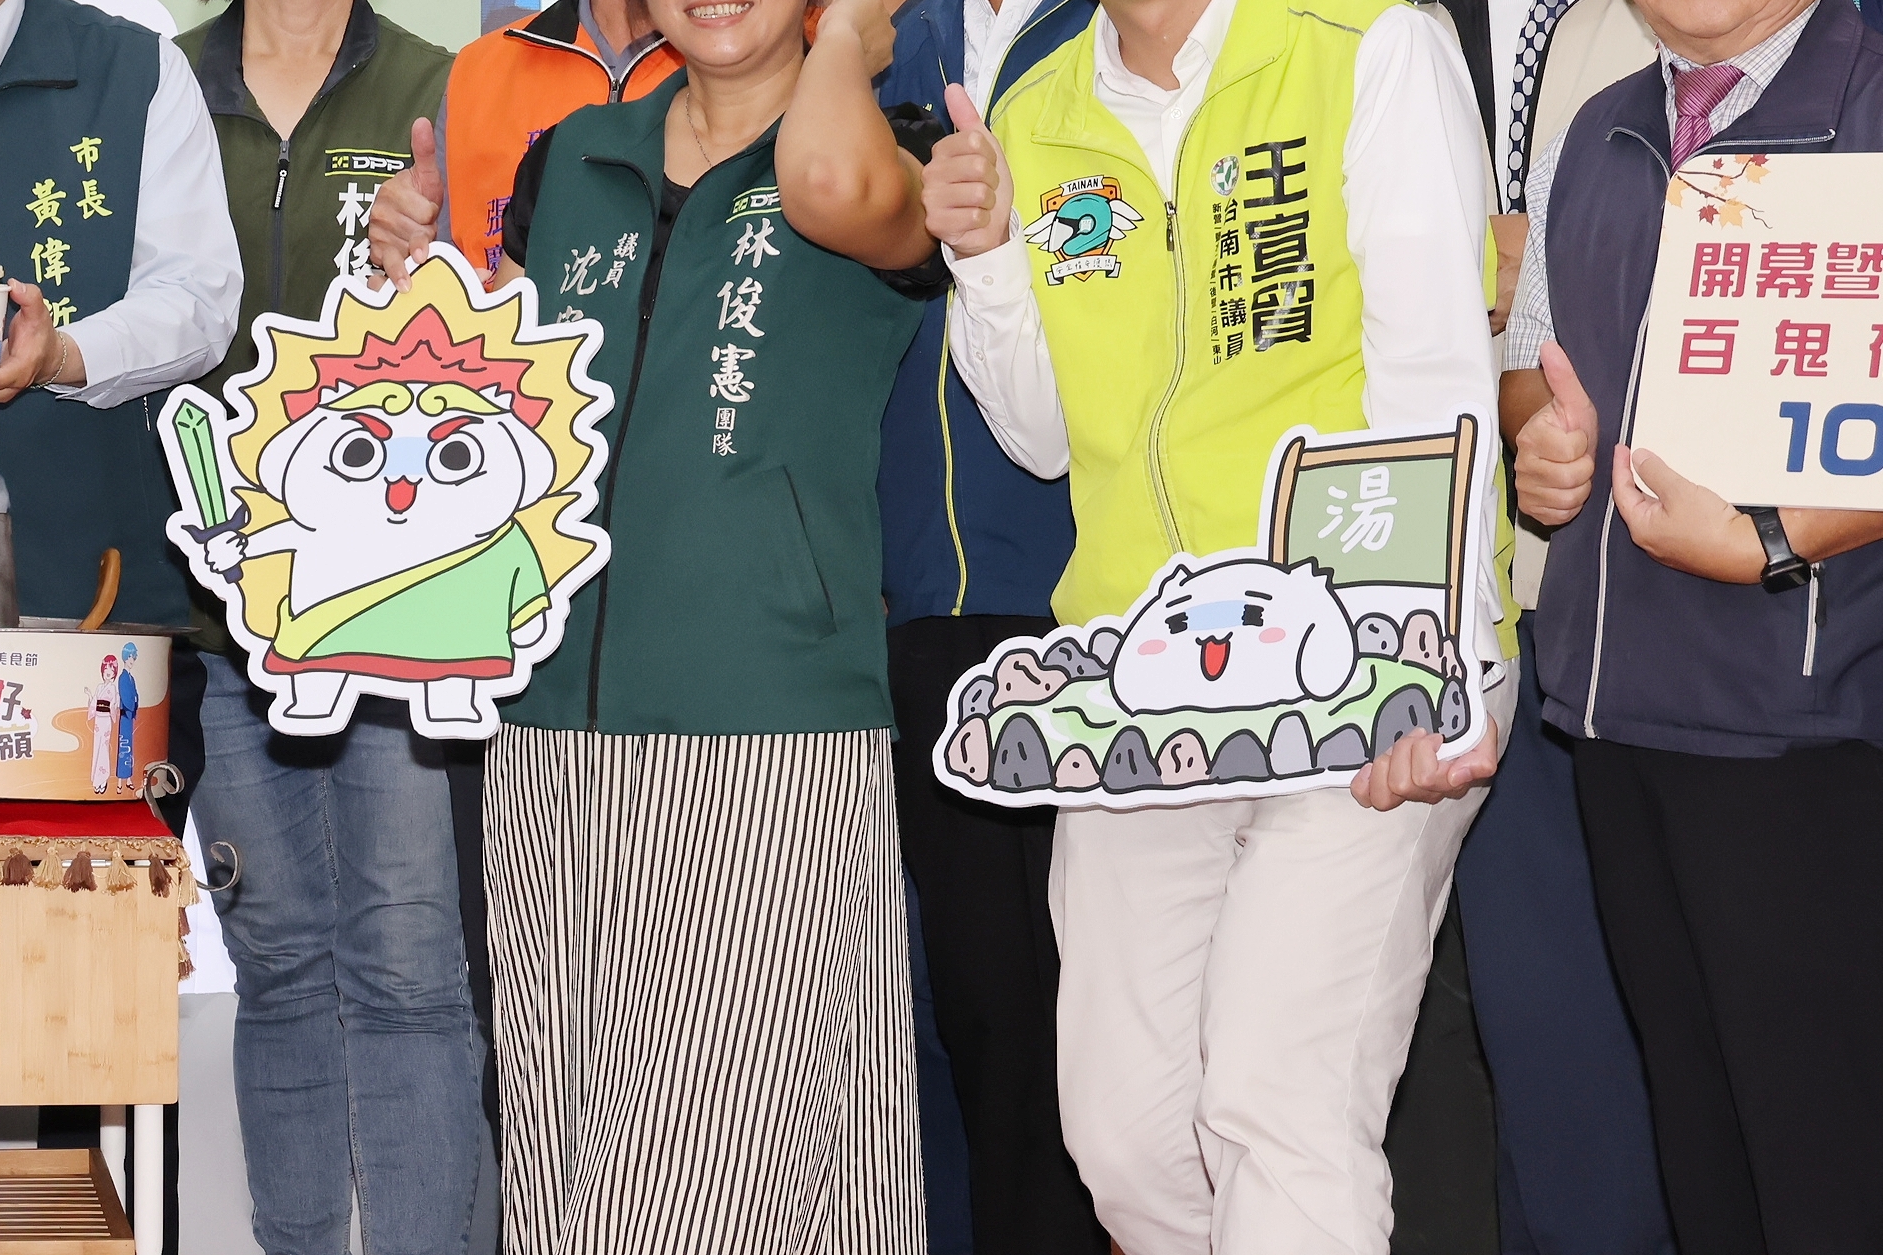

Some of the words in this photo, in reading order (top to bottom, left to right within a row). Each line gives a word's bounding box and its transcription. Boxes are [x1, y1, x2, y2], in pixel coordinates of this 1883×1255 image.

[69, 136, 113, 220] 市長
[352, 156, 405, 171] DPP
[1066, 177, 1099, 193] TAINAN
[601, 232, 639, 288] 議員
[1218, 197, 1247, 361] 台南市議員
[1689, 242, 1883, 299] 開幕暨
[710, 217, 781, 403] 林俊憲
[712, 407, 737, 456] 團隊
[1317, 465, 1398, 554] 湯
